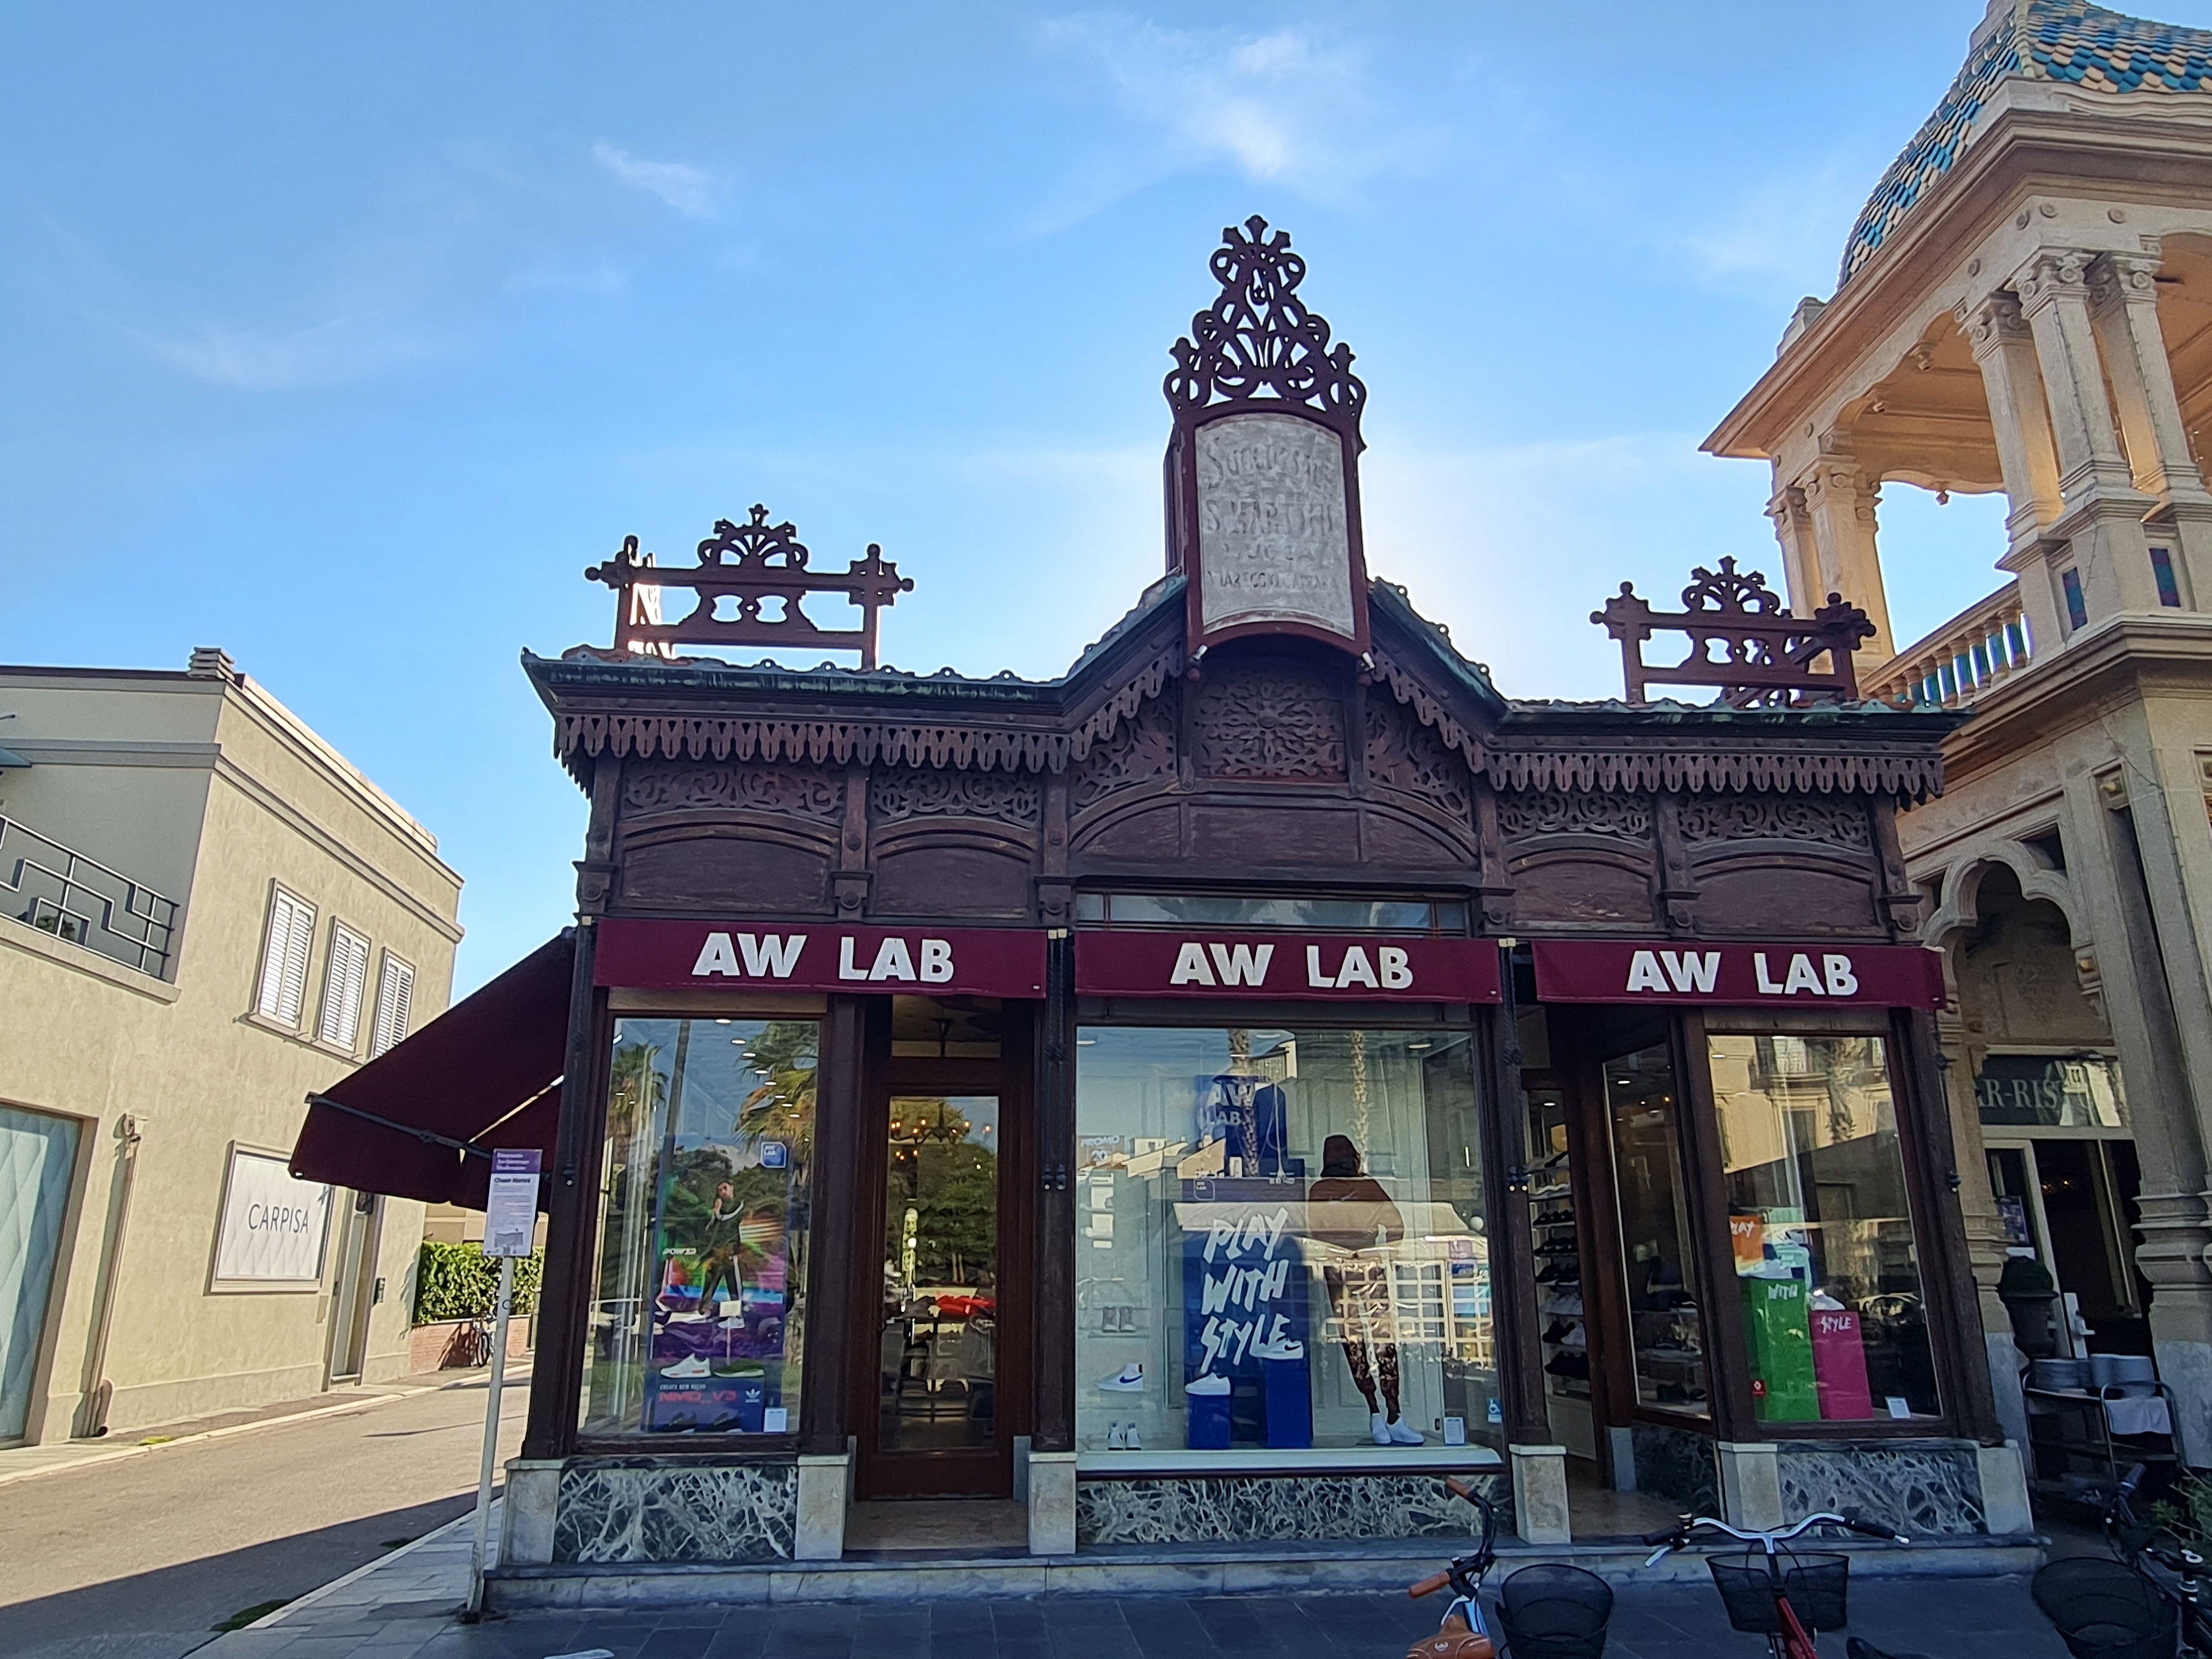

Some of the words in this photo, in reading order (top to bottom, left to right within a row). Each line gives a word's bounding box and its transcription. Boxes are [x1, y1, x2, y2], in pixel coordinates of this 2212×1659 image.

[691, 932, 807, 978] AW
[839, 936, 954, 983] LAB
[1170, 942, 1275, 986] AW
[1306, 945, 1413, 989] LAB
[1626, 951, 1721, 993] AW
[1754, 952, 1858, 995] LAB
[248, 1203, 309, 1234] CARPISA
[1203, 1207, 1288, 1264] PLAY
[1201, 1259, 1290, 1315] WITH
[1199, 1313, 1291, 1374] STYLE
[1820, 1316, 1852, 1334] STYLE
